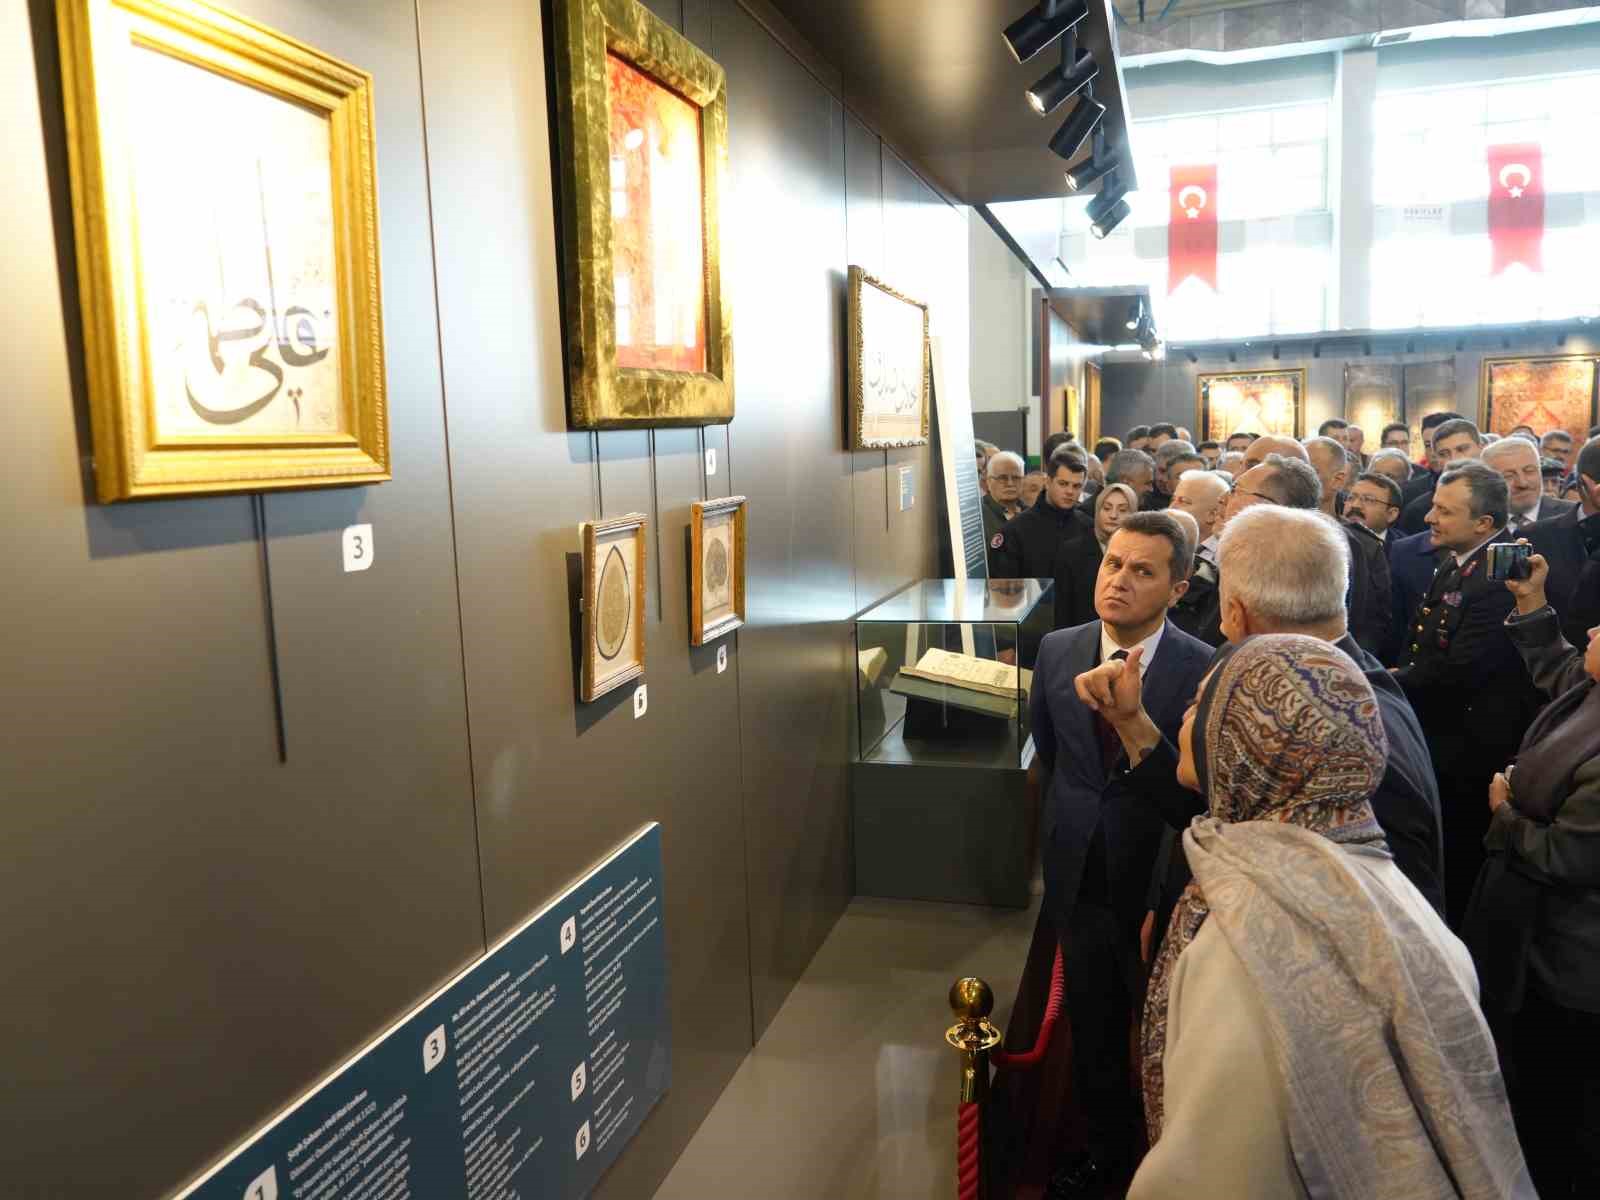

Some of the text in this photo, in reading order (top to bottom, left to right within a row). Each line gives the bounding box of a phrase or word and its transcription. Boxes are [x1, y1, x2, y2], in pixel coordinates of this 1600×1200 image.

[353, 535, 364, 559] 3
[565, 926, 571, 941] 4
[430, 1039, 439, 1059] 3
[576, 1073, 582, 1090] 5
[580, 1131, 585, 1147] 6
